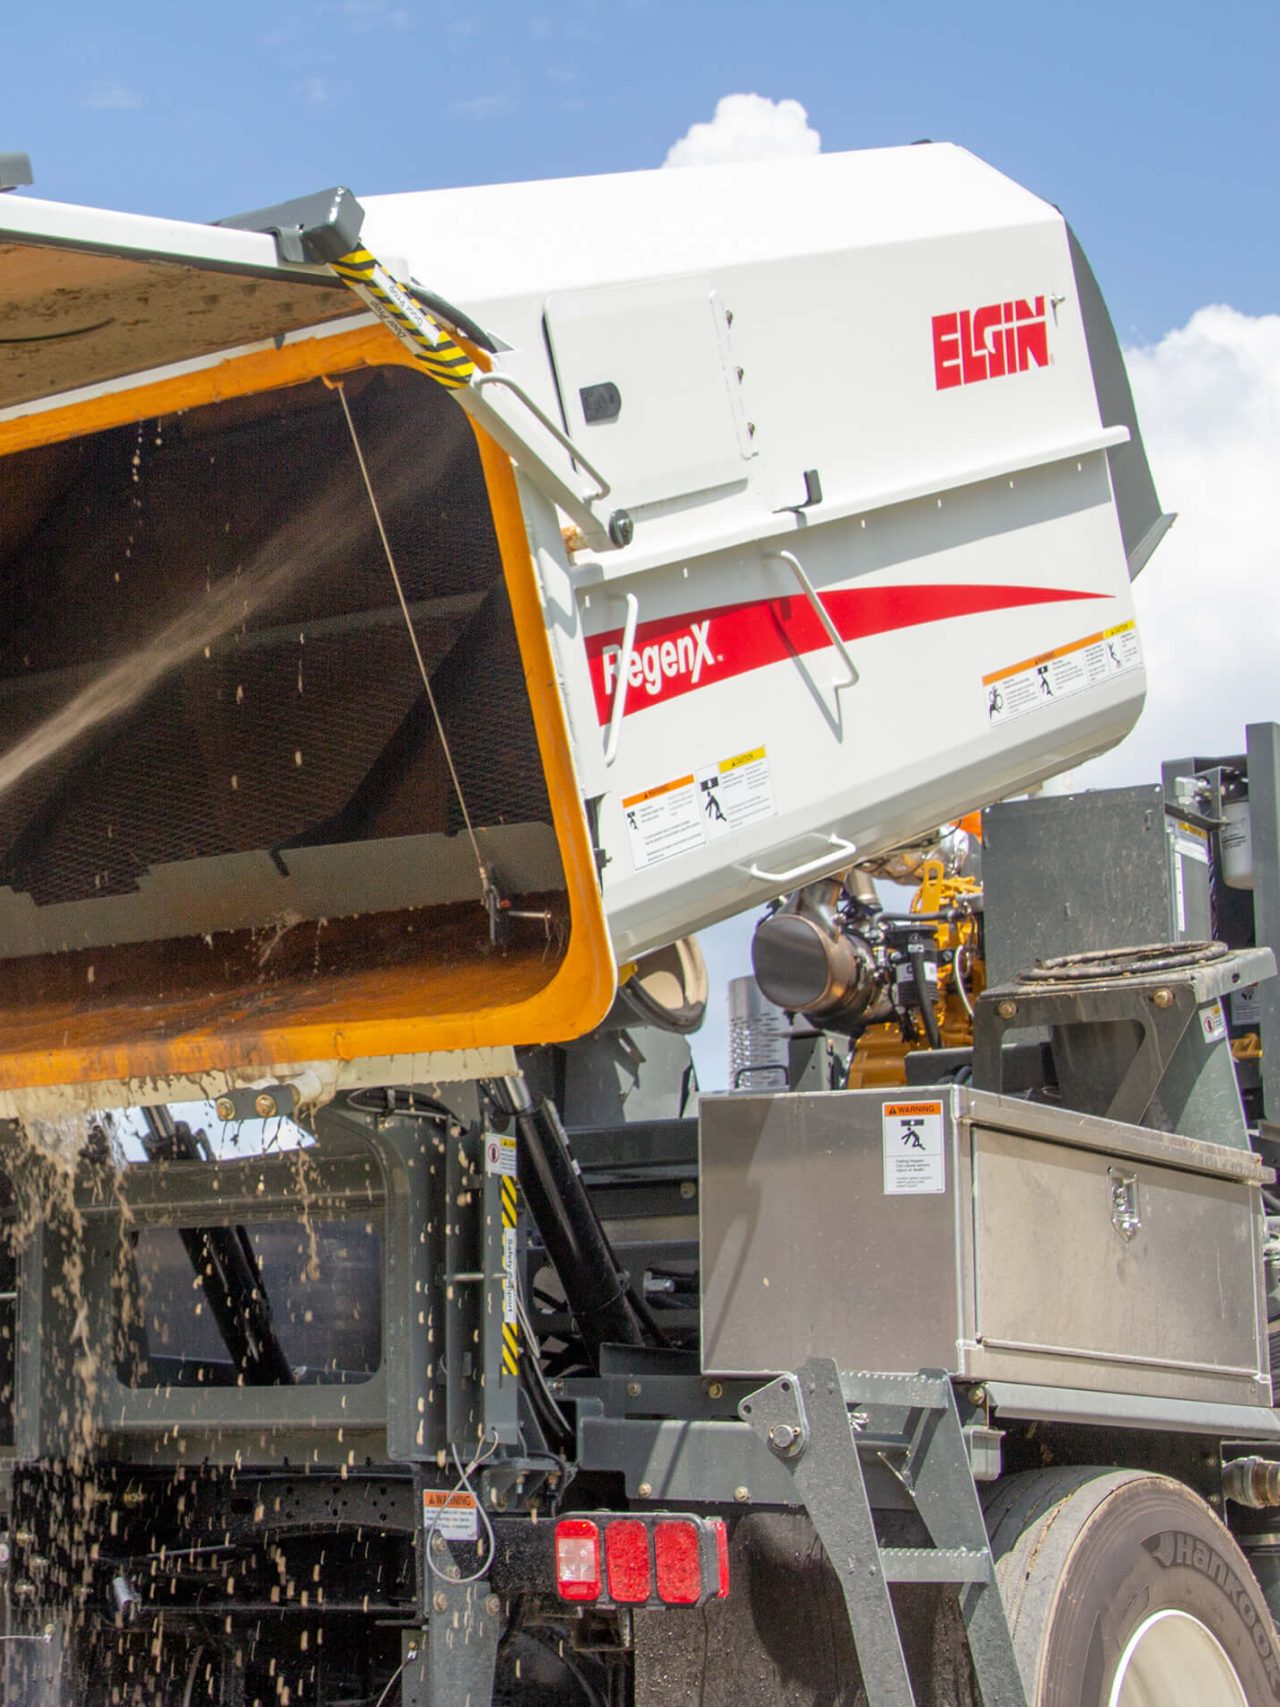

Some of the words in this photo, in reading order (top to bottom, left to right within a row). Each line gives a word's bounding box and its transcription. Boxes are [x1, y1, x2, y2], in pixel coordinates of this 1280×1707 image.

[370, 300, 389, 320] Prop
[387, 318, 407, 338] Door
[931, 295, 1049, 391] ELGIN
[602, 620, 715, 696] RegenX
[897, 1105, 935, 1114] WARNING
